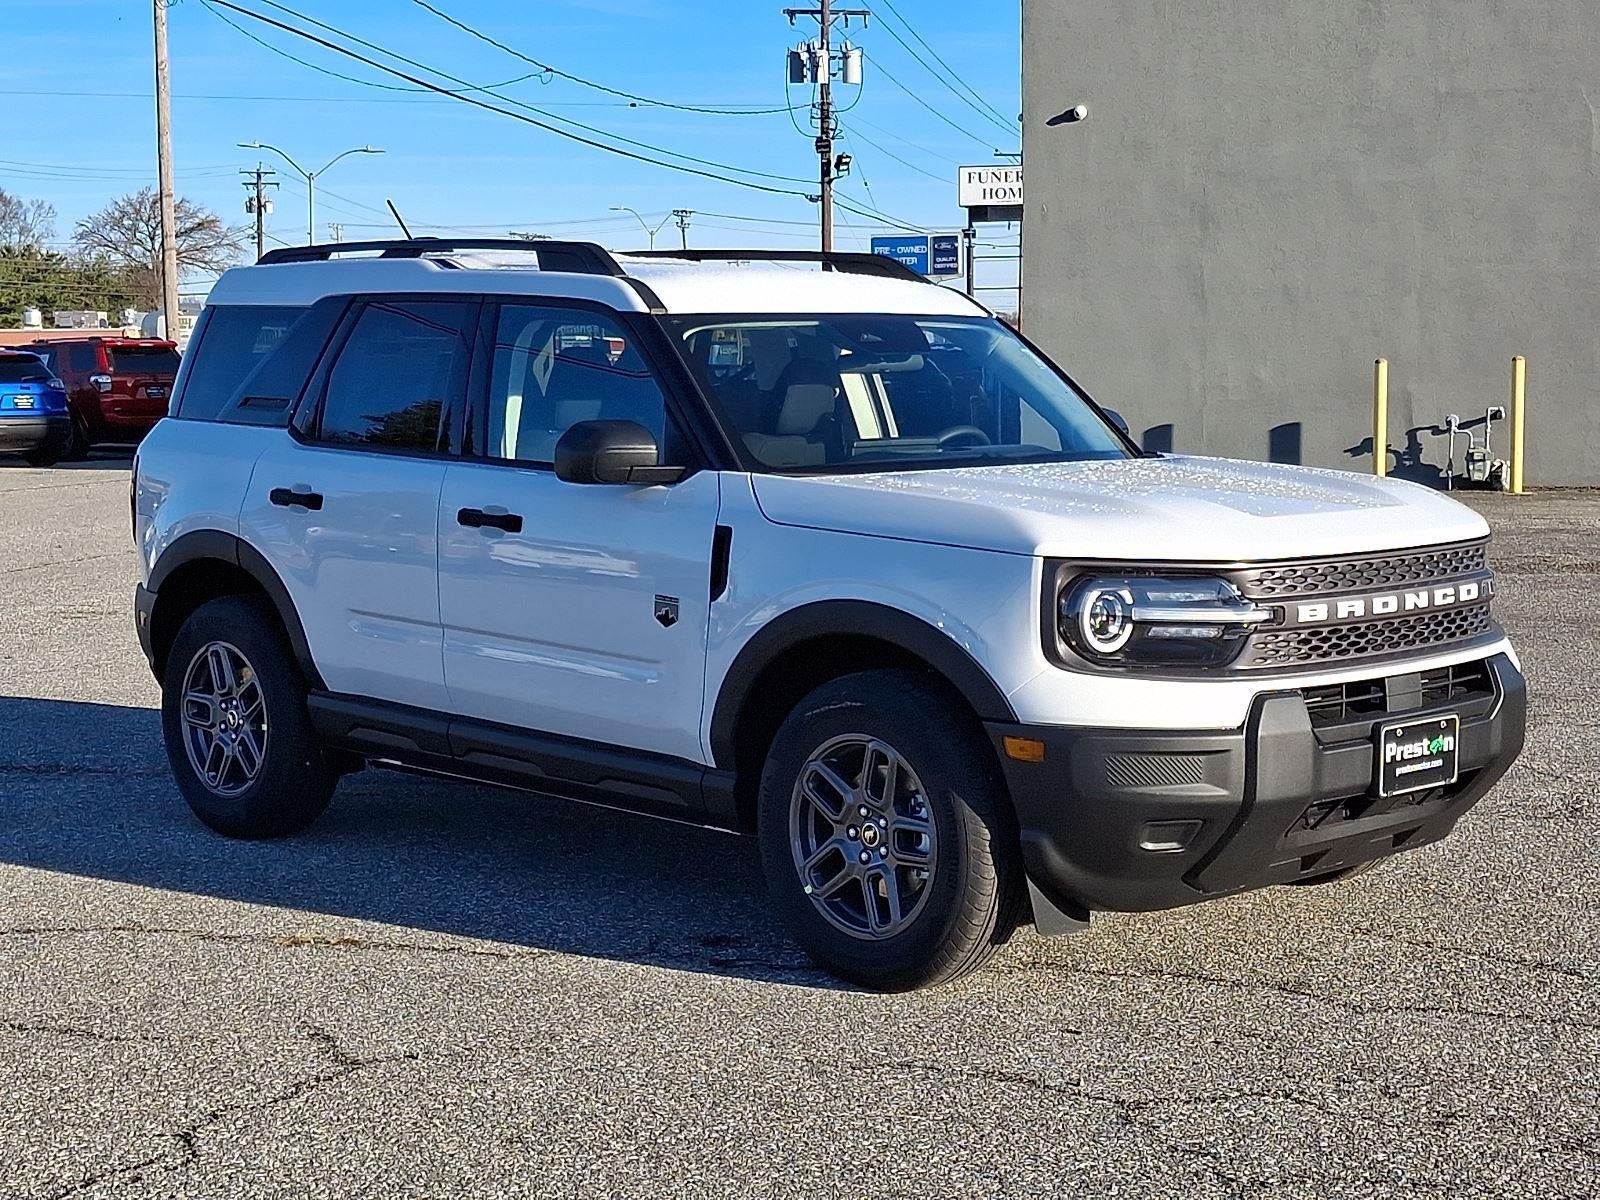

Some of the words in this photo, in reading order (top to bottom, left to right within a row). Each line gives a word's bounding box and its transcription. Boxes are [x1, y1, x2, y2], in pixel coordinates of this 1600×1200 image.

[982, 187, 1022, 200] HOM
[896, 245, 928, 254] OWNED
[1297, 582, 1480, 623] BRONCO
